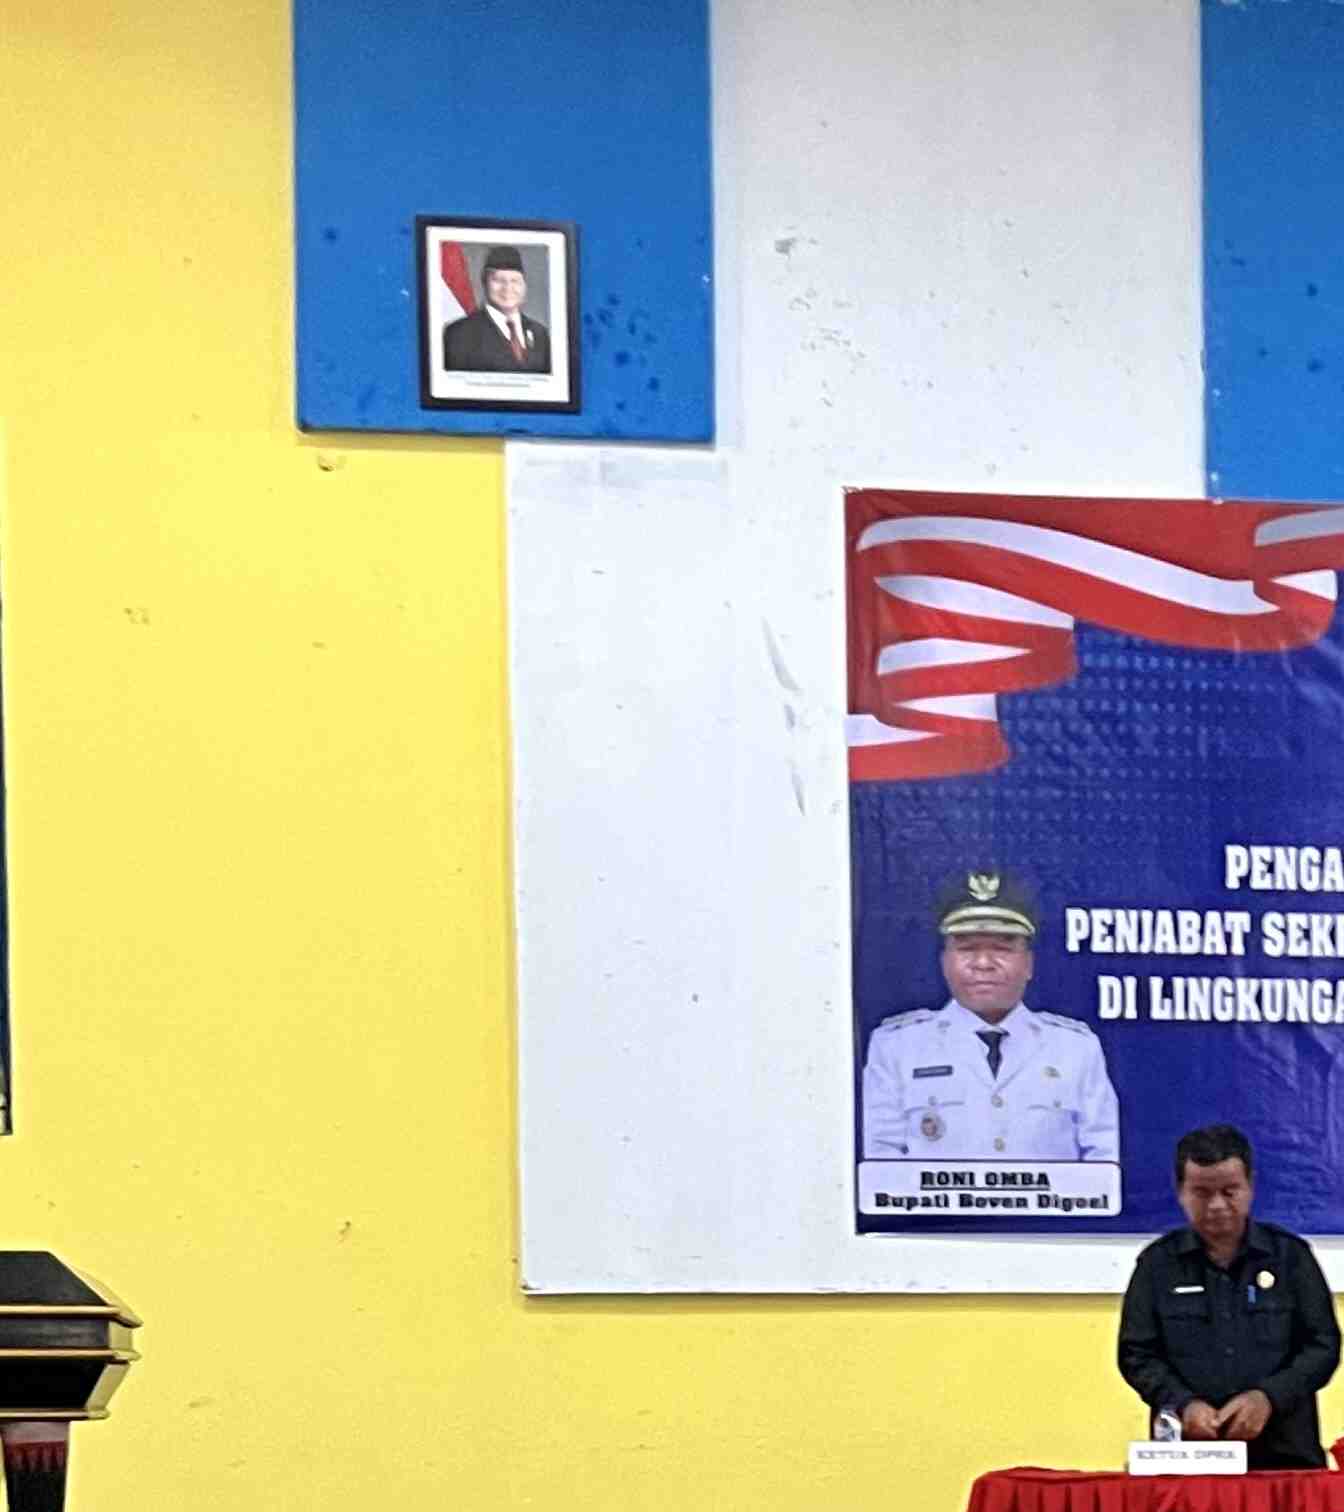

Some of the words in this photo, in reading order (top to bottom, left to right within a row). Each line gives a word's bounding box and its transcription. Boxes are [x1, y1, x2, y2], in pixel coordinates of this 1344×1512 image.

[1065, 907, 1251, 956] PENJABAT
[1098, 975, 1137, 1020] DI
[920, 1171, 975, 1186] RONI
[985, 1171, 1050, 1186] OMBA
[875, 1193, 950, 1210] Bupati
[959, 1193, 1028, 1208] Boven
[1037, 1194, 1109, 1211] Digoel
